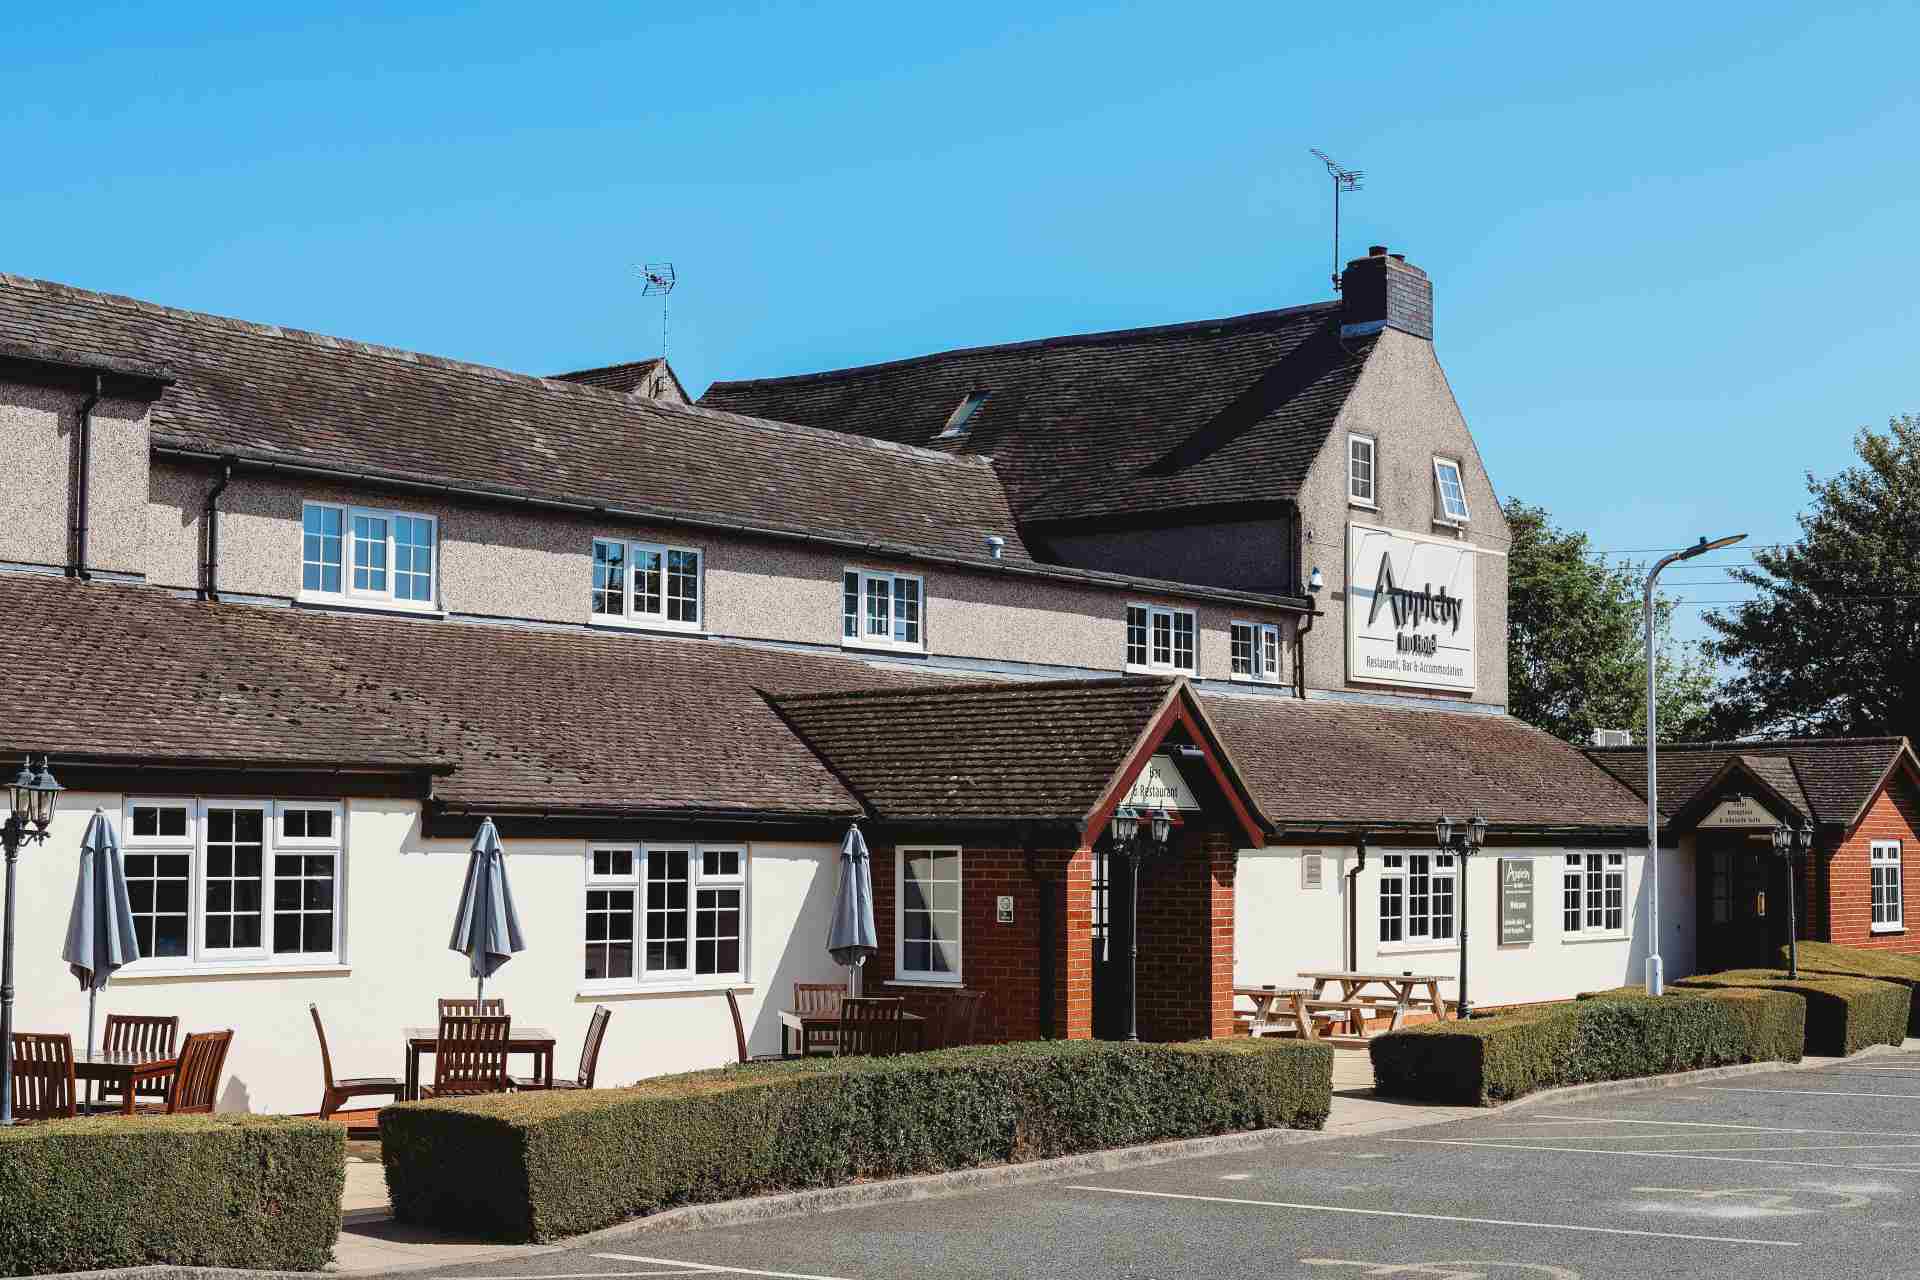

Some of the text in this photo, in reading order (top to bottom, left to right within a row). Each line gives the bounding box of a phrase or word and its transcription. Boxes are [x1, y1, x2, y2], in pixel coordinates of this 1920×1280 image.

[1368, 552, 1463, 635] Appleby
[1367, 656, 1401, 672] Restaurant,
[1402, 660, 1412, 672] Bar
[1420, 662, 1464, 677] Accommodation
[1140, 786, 1178, 798] Restaurant
